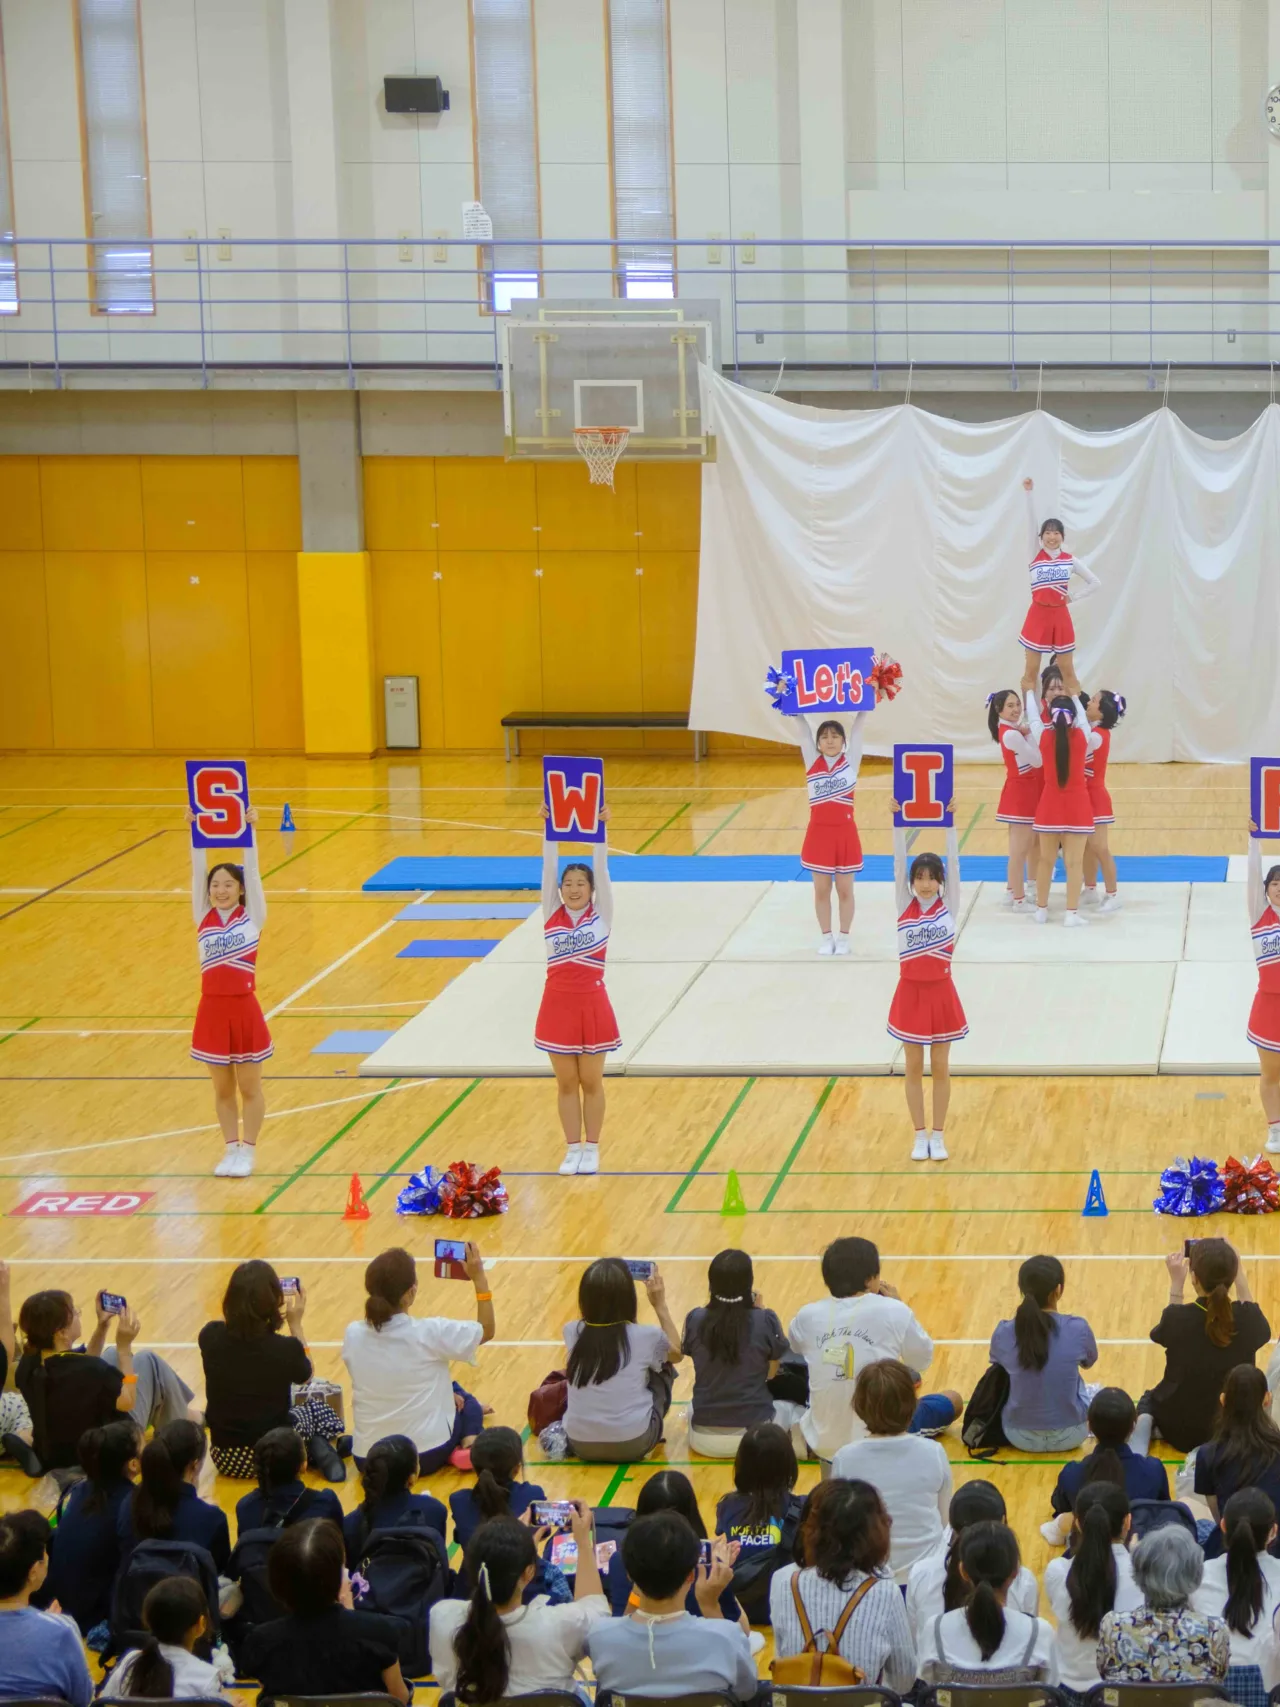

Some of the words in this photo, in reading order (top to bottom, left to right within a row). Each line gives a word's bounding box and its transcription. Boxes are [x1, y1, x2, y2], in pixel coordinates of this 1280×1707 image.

[793, 658, 864, 708] Let's
[193, 767, 247, 838] S
[546, 770, 601, 834] W
[902, 751, 944, 821] I
[26, 1195, 141, 1213] RED
[839, 1326, 852, 1336] The
[740, 1534, 769, 1546] FACE
